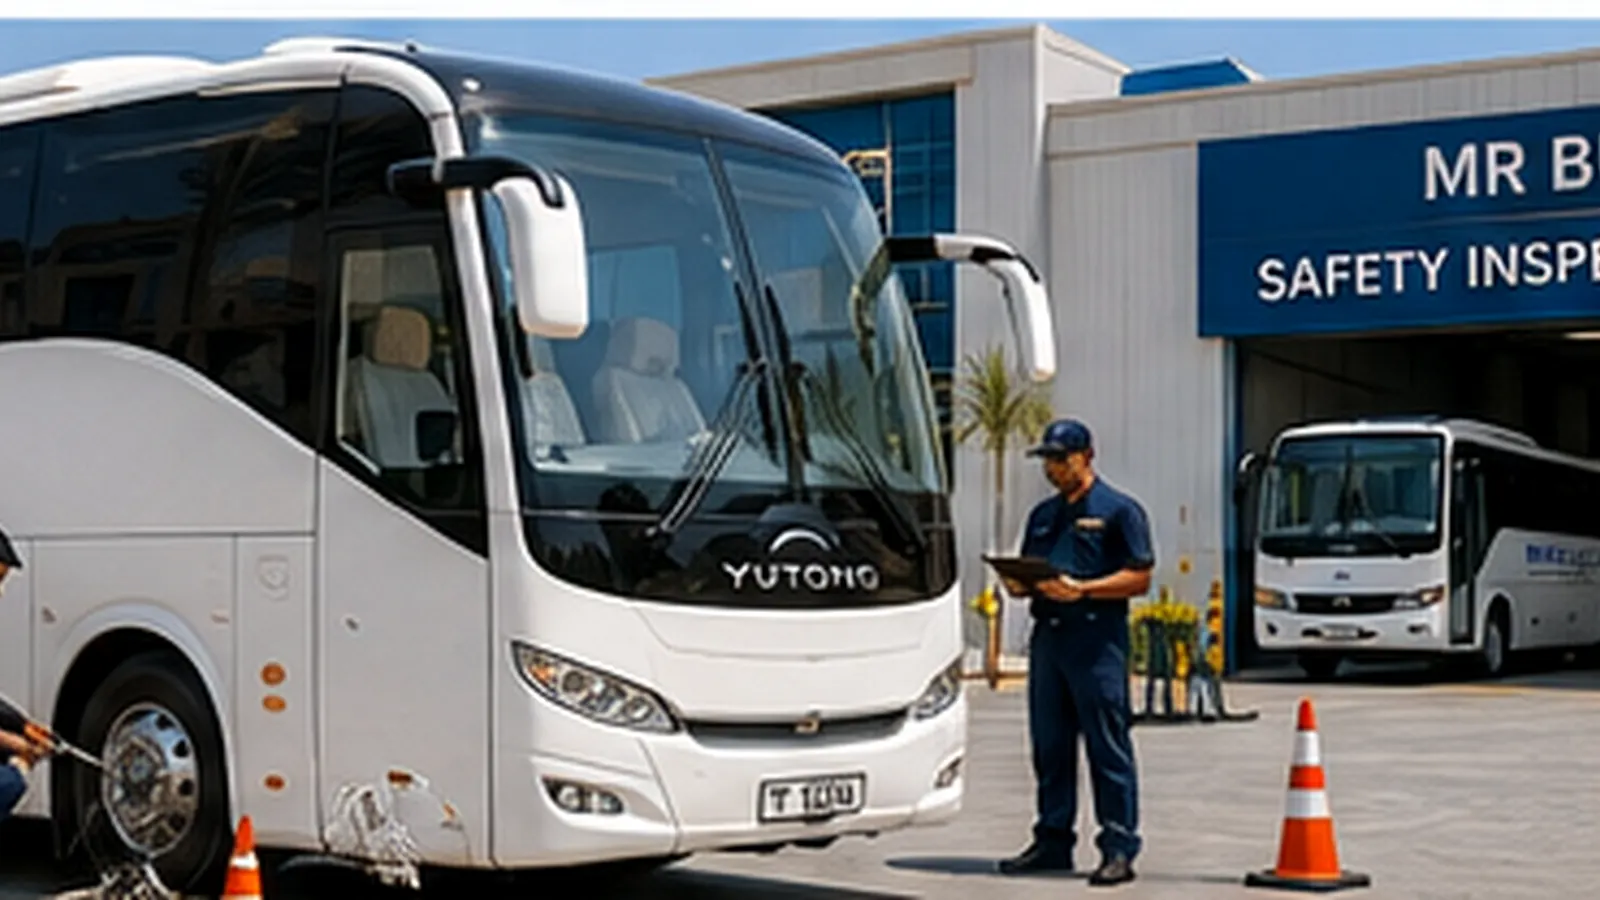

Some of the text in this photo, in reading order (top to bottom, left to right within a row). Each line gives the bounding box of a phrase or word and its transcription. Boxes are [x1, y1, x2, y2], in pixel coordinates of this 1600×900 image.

[1424, 135, 1600, 200] MR B
[1257, 247, 1449, 301] SAFETY
